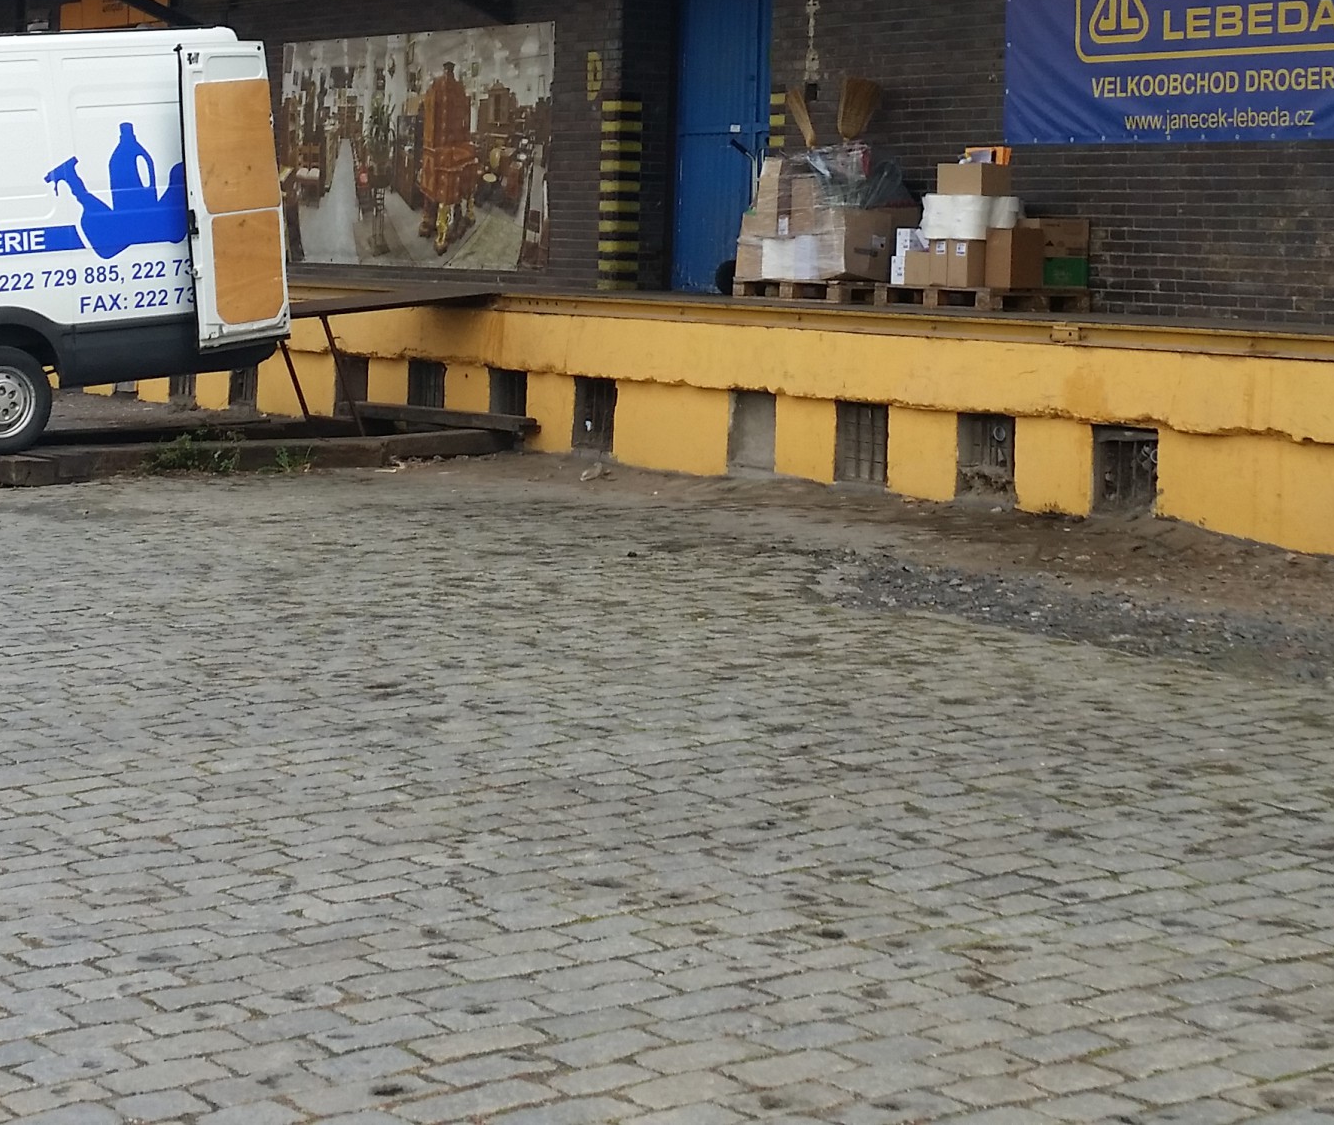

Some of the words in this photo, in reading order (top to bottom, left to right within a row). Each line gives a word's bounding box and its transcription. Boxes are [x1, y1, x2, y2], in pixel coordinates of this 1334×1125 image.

[1091, 70, 1240, 98] VELKOOBCHOD
[1124, 106, 1315, 134] www.janecek-lebeda.cz
[42, 268, 77, 289] 729
[84, 264, 125, 284] 885,
[132, 260, 166, 281] 222
[80, 293, 128, 314] FAX:
[134, 290, 168, 310] 222
